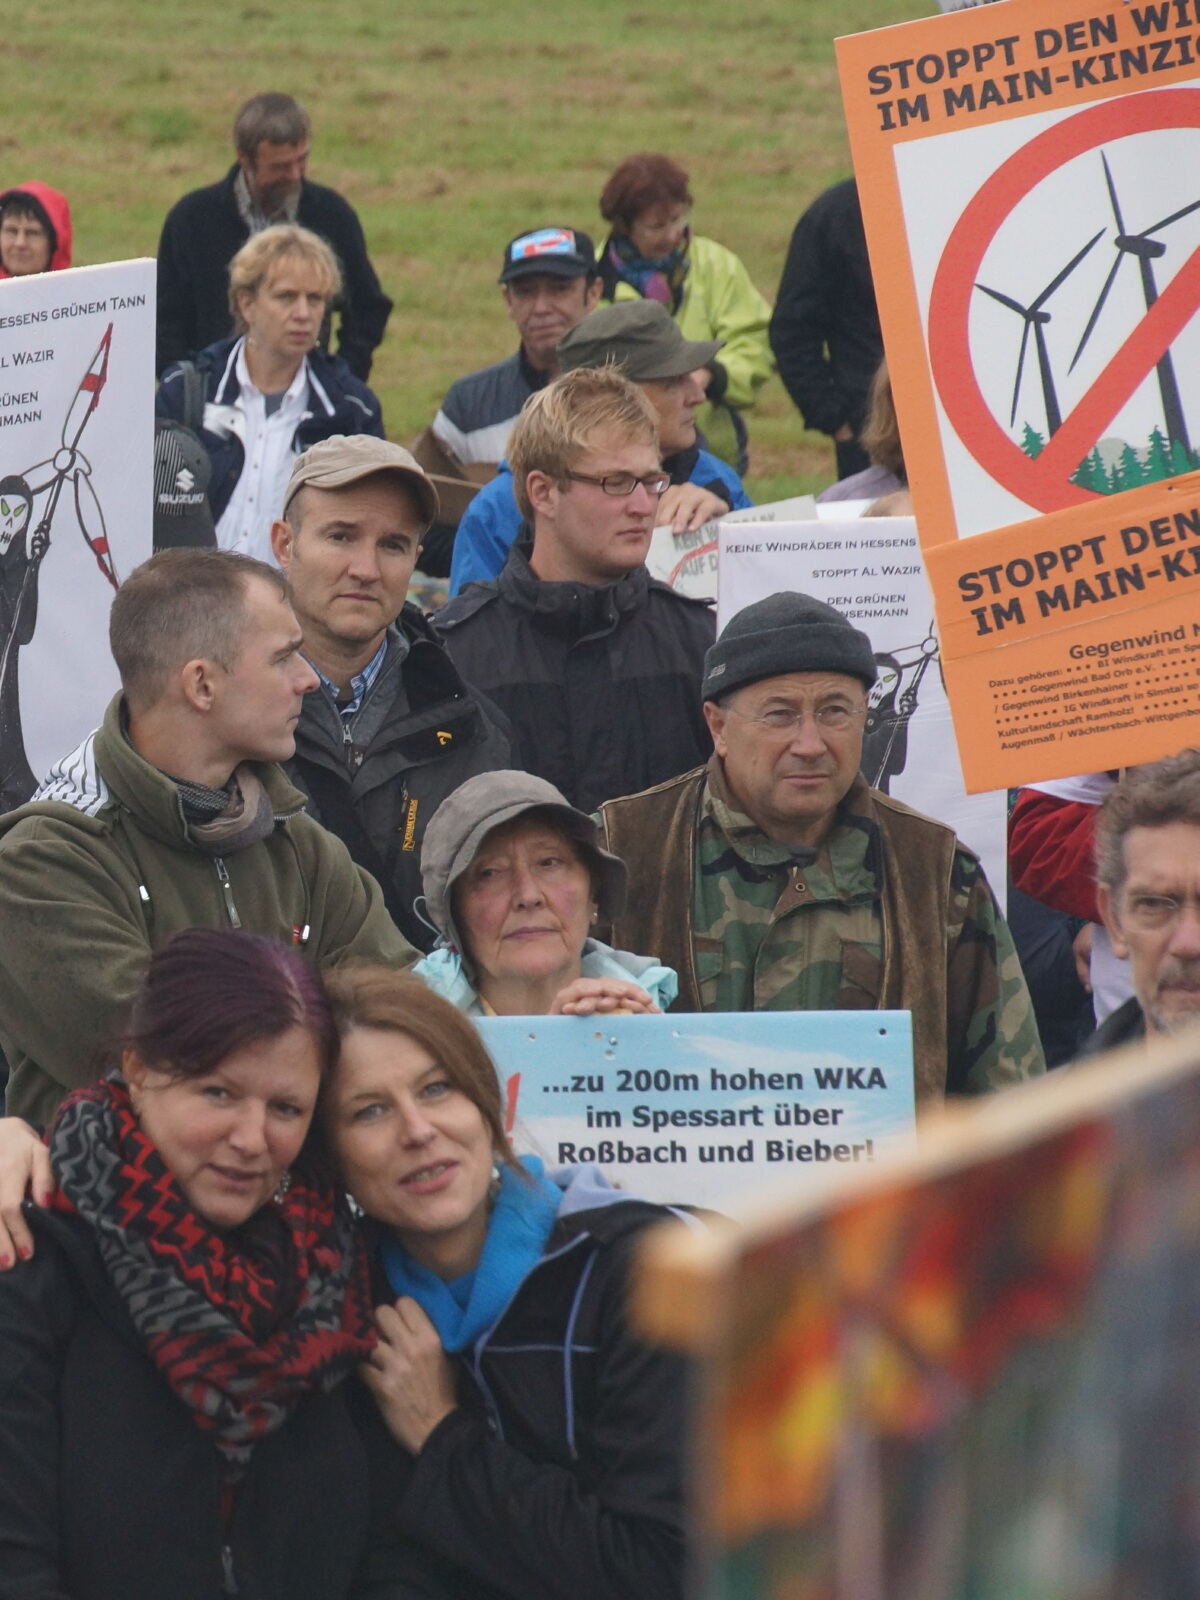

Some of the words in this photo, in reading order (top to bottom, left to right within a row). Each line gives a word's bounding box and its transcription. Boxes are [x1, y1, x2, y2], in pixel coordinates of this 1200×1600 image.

[867, 35, 1020, 96] STOPPT
[1034, 14, 1118, 60] DEN
[1130, 0, 1200, 36] WI
[877, 94, 930, 131] IM
[943, 34, 1200, 118] MAIN-KINZI
[51, 300, 107, 320] GRÜNEM
[110, 294, 146, 311] TANN
[13, 349, 55, 367] WAZIR
[726, 543, 763, 554] KEINE
[766, 540, 842, 552] WINDRÄDER
[845, 540, 858, 550] IN
[860, 537, 917, 549] HESSENS
[957, 534, 1106, 603] STOPPT
[1120, 507, 1200, 557] DEN
[812, 567, 858, 578] STOPPT
[861, 566, 879, 577] AL
[881, 565, 922, 577] WAZIR
[827, 595, 851, 606] DEN
[855, 593, 906, 605] GRÜNEN
[970, 597, 1026, 637] IM
[1069, 625, 1186, 660] Gegenwind
[989, 677, 1014, 688] Dazu
[1112, 648, 1165, 665] Windkraft
[1167, 646, 1182, 655] im
[1030, 675, 1089, 693] Gegenwind
[1090, 671, 1112, 682] Bad
[1113, 667, 1133, 678] Orb
[1002, 694, 1060, 712] Gegenwind
[1062, 681, 1129, 701] Birkenhainer
[1064, 703, 1077, 713] IG
[1079, 693, 1132, 710] Windkraft
[1134, 690, 1145, 700] in
[997, 715, 1084, 738] Kulturlandschaft
[1000, 733, 1057, 751] Augenmaß
[616, 1070, 699, 1092] 200m
[711, 1067, 803, 1091] hohen
[814, 1067, 888, 1090] WKA
[586, 1104, 622, 1128] im
[632, 1104, 763, 1133] Spessart
[774, 1103, 844, 1127] über
[557, 1140, 688, 1165] Roßbach
[699, 1139, 755, 1163] und
[766, 1138, 875, 1163] Bieber!
